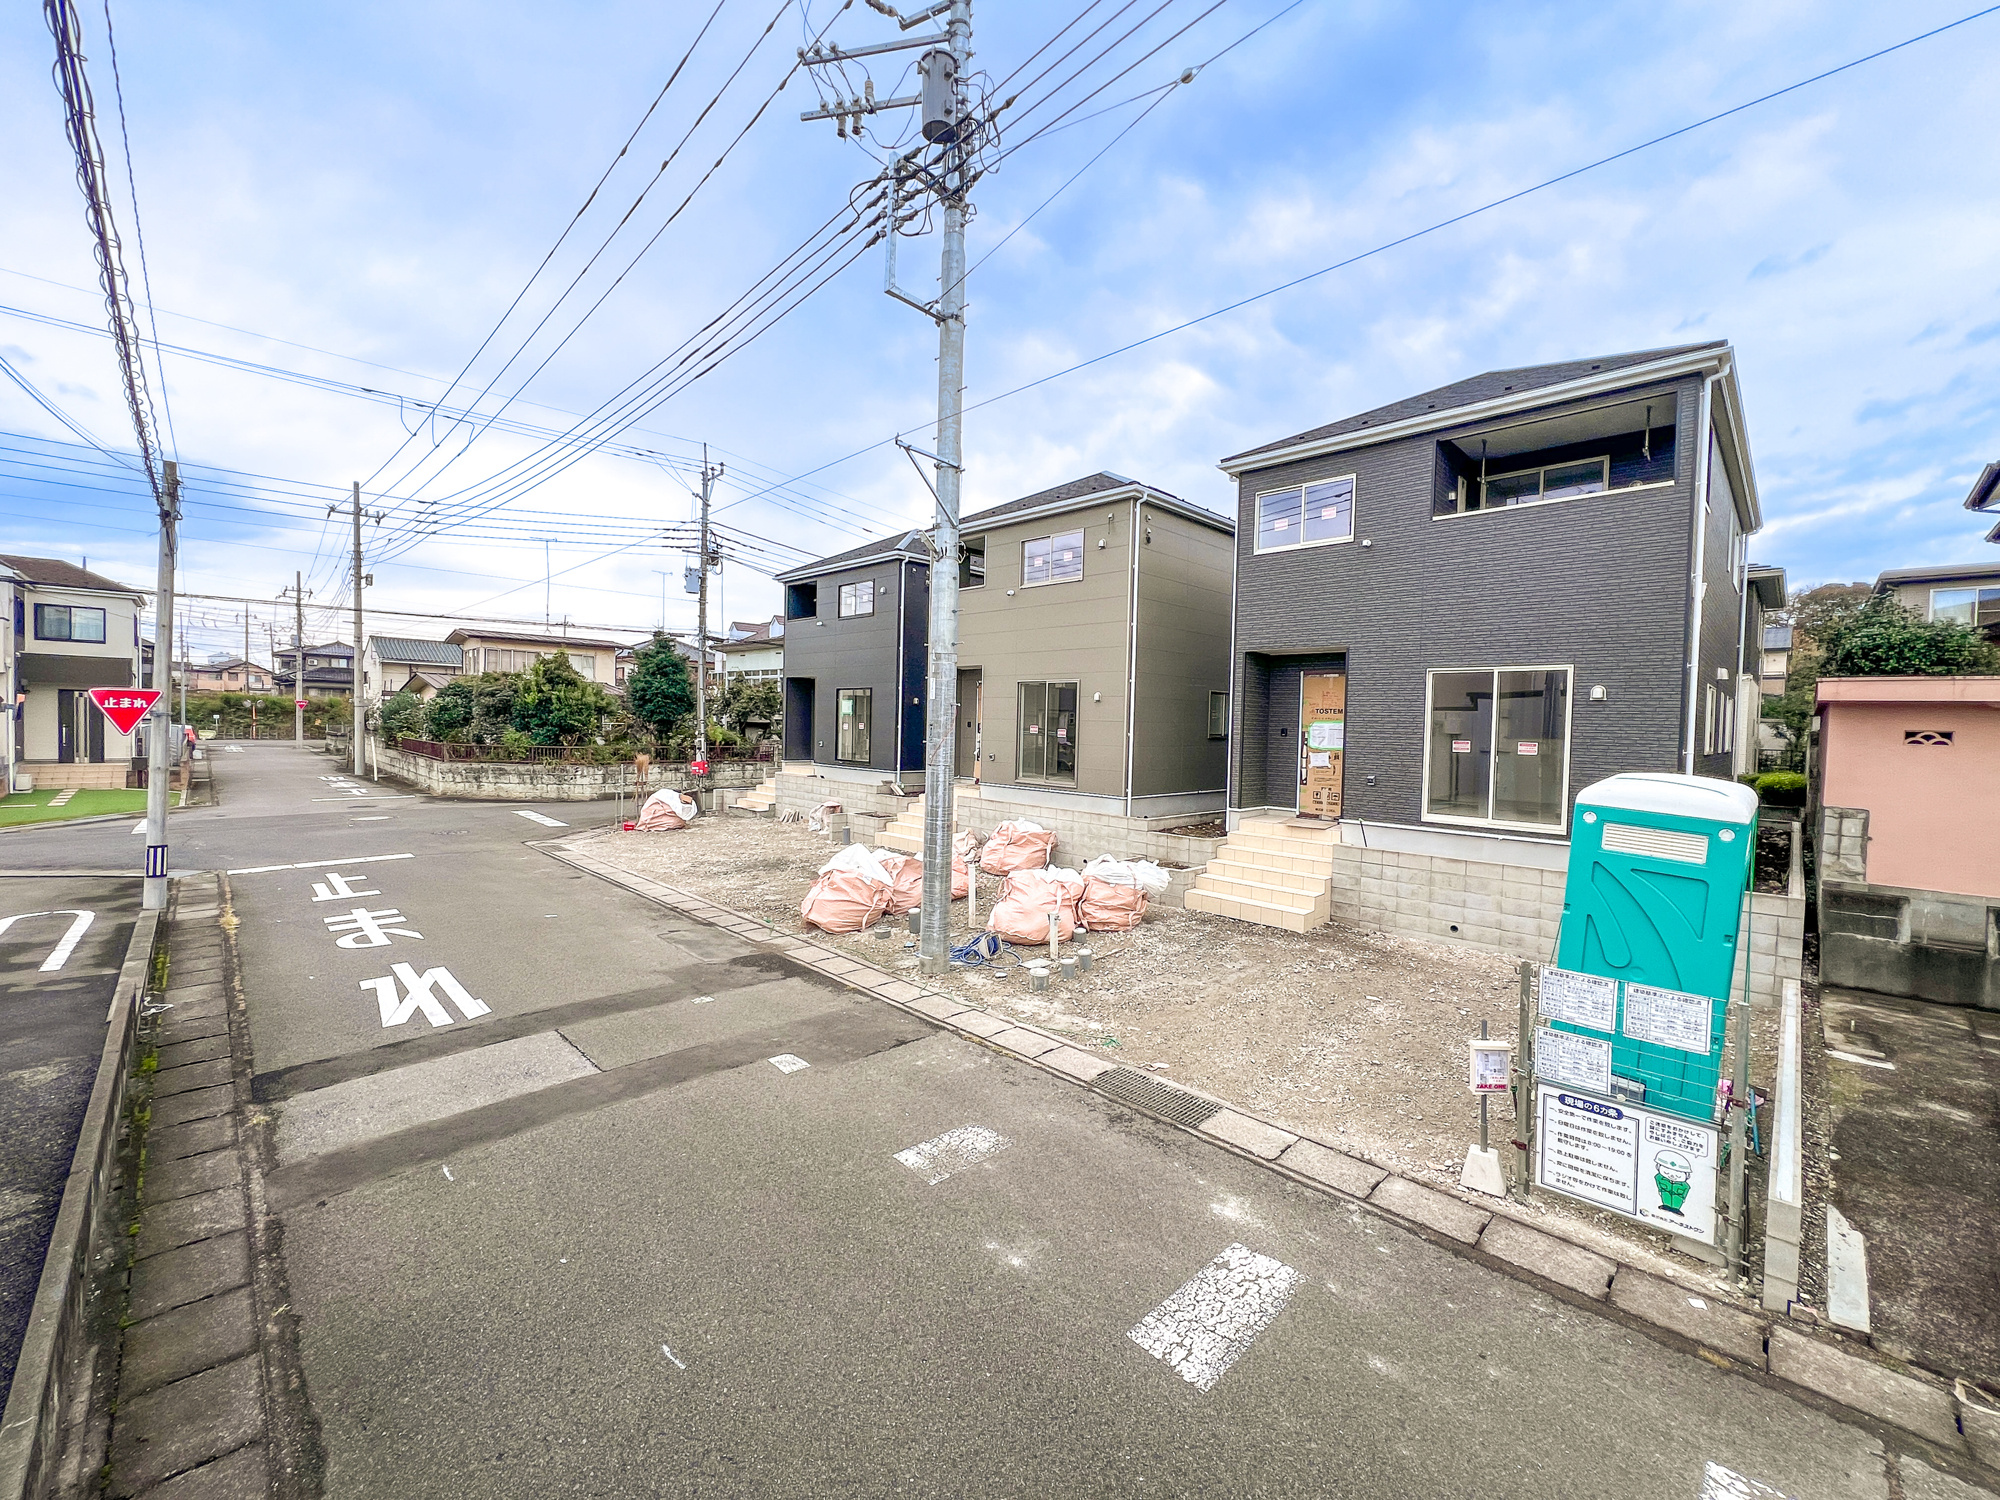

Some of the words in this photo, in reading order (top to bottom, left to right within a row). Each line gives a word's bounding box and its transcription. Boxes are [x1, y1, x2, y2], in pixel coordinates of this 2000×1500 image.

[102, 697, 148, 709] 止まれ
[310, 872, 494, 1028] 止まれ
